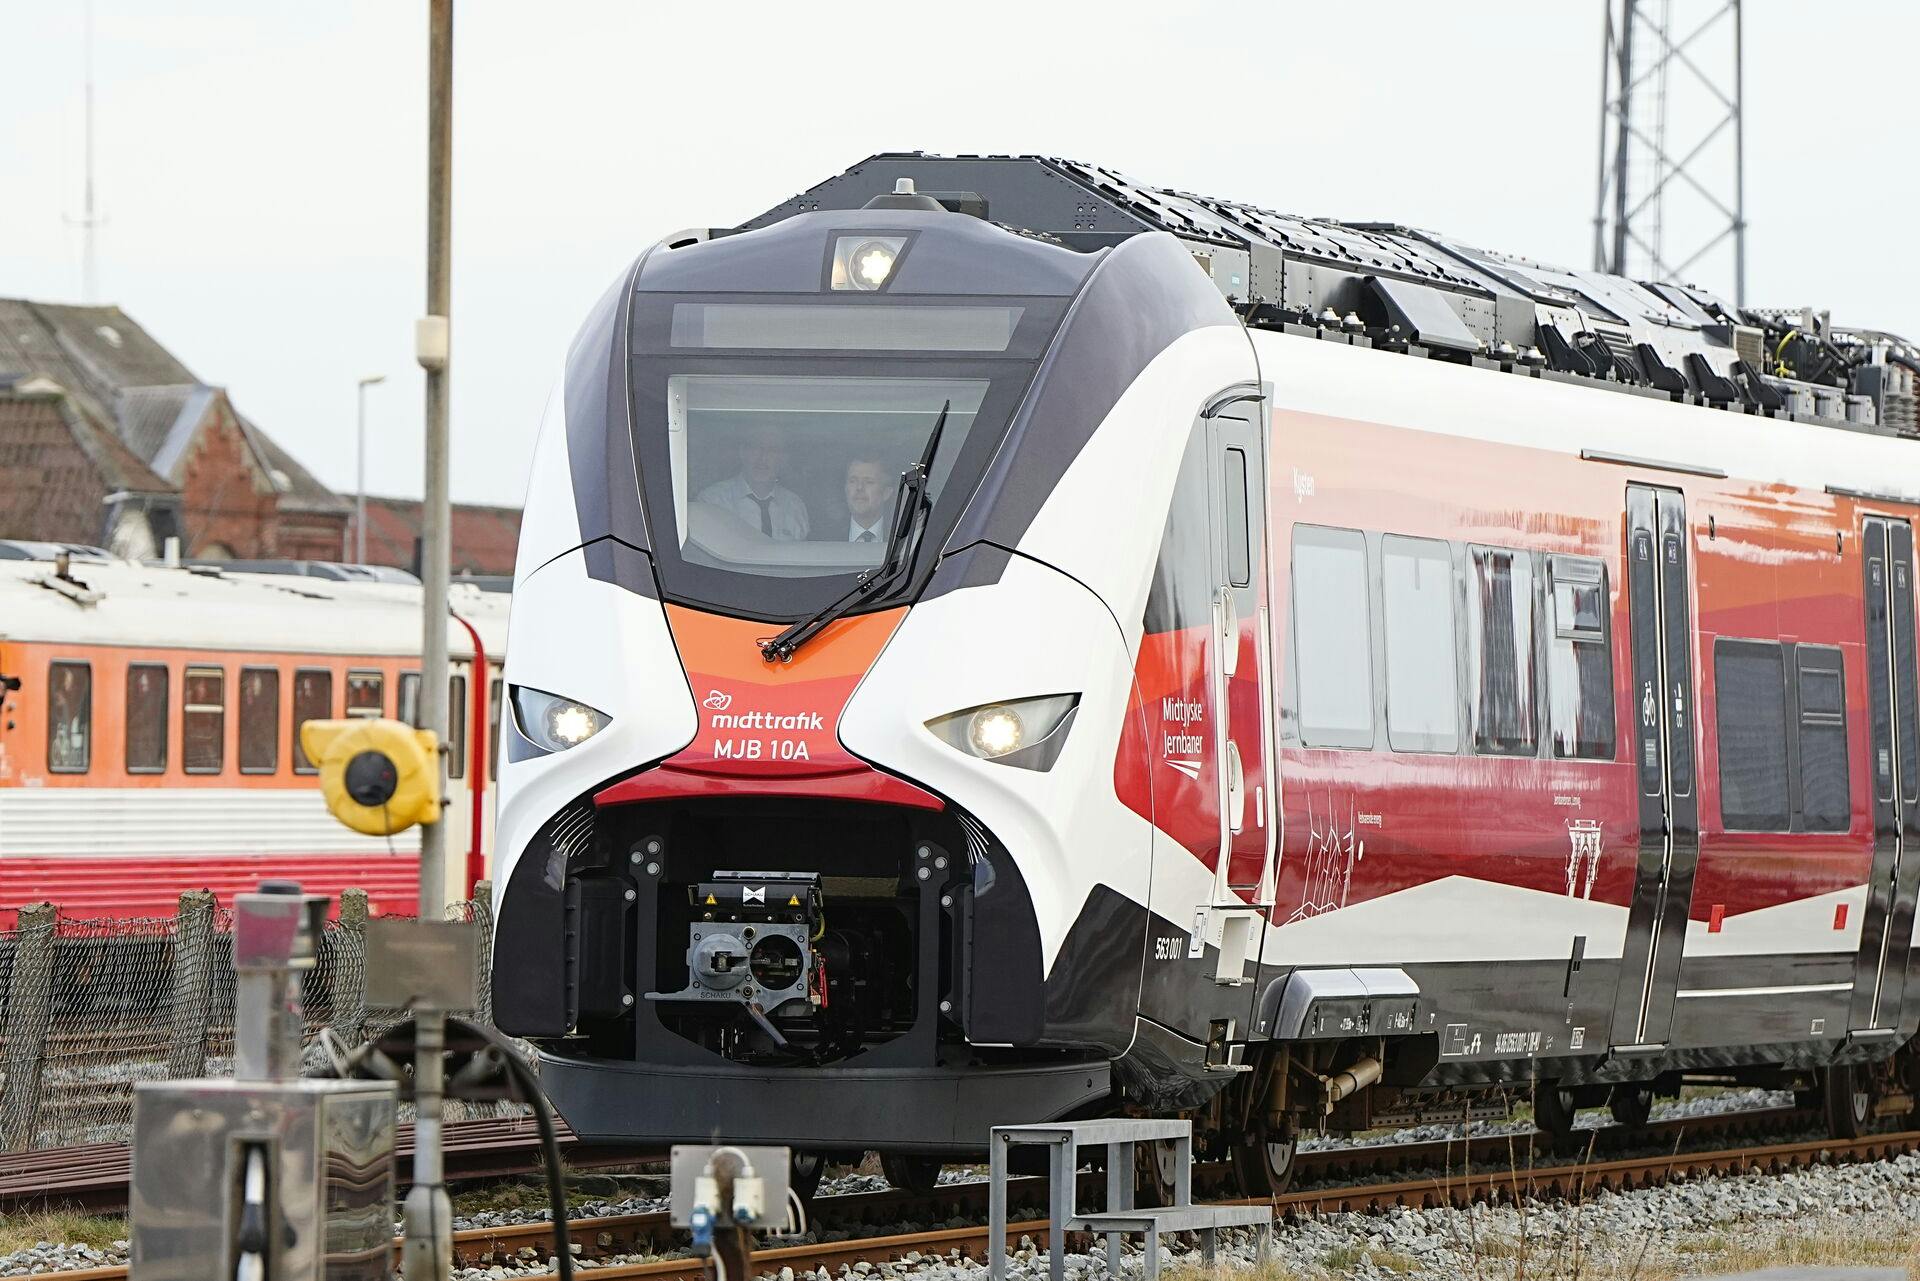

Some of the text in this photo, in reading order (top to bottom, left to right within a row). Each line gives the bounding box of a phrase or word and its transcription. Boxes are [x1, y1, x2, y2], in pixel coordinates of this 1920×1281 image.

[712, 711, 824, 730] midttrafik
[1163, 697, 1203, 727] Midtjyske
[713, 739, 810, 760] MJB 10A
[1163, 729, 1203, 758] Jernbaner
[1155, 937, 1183, 960] 563 001
